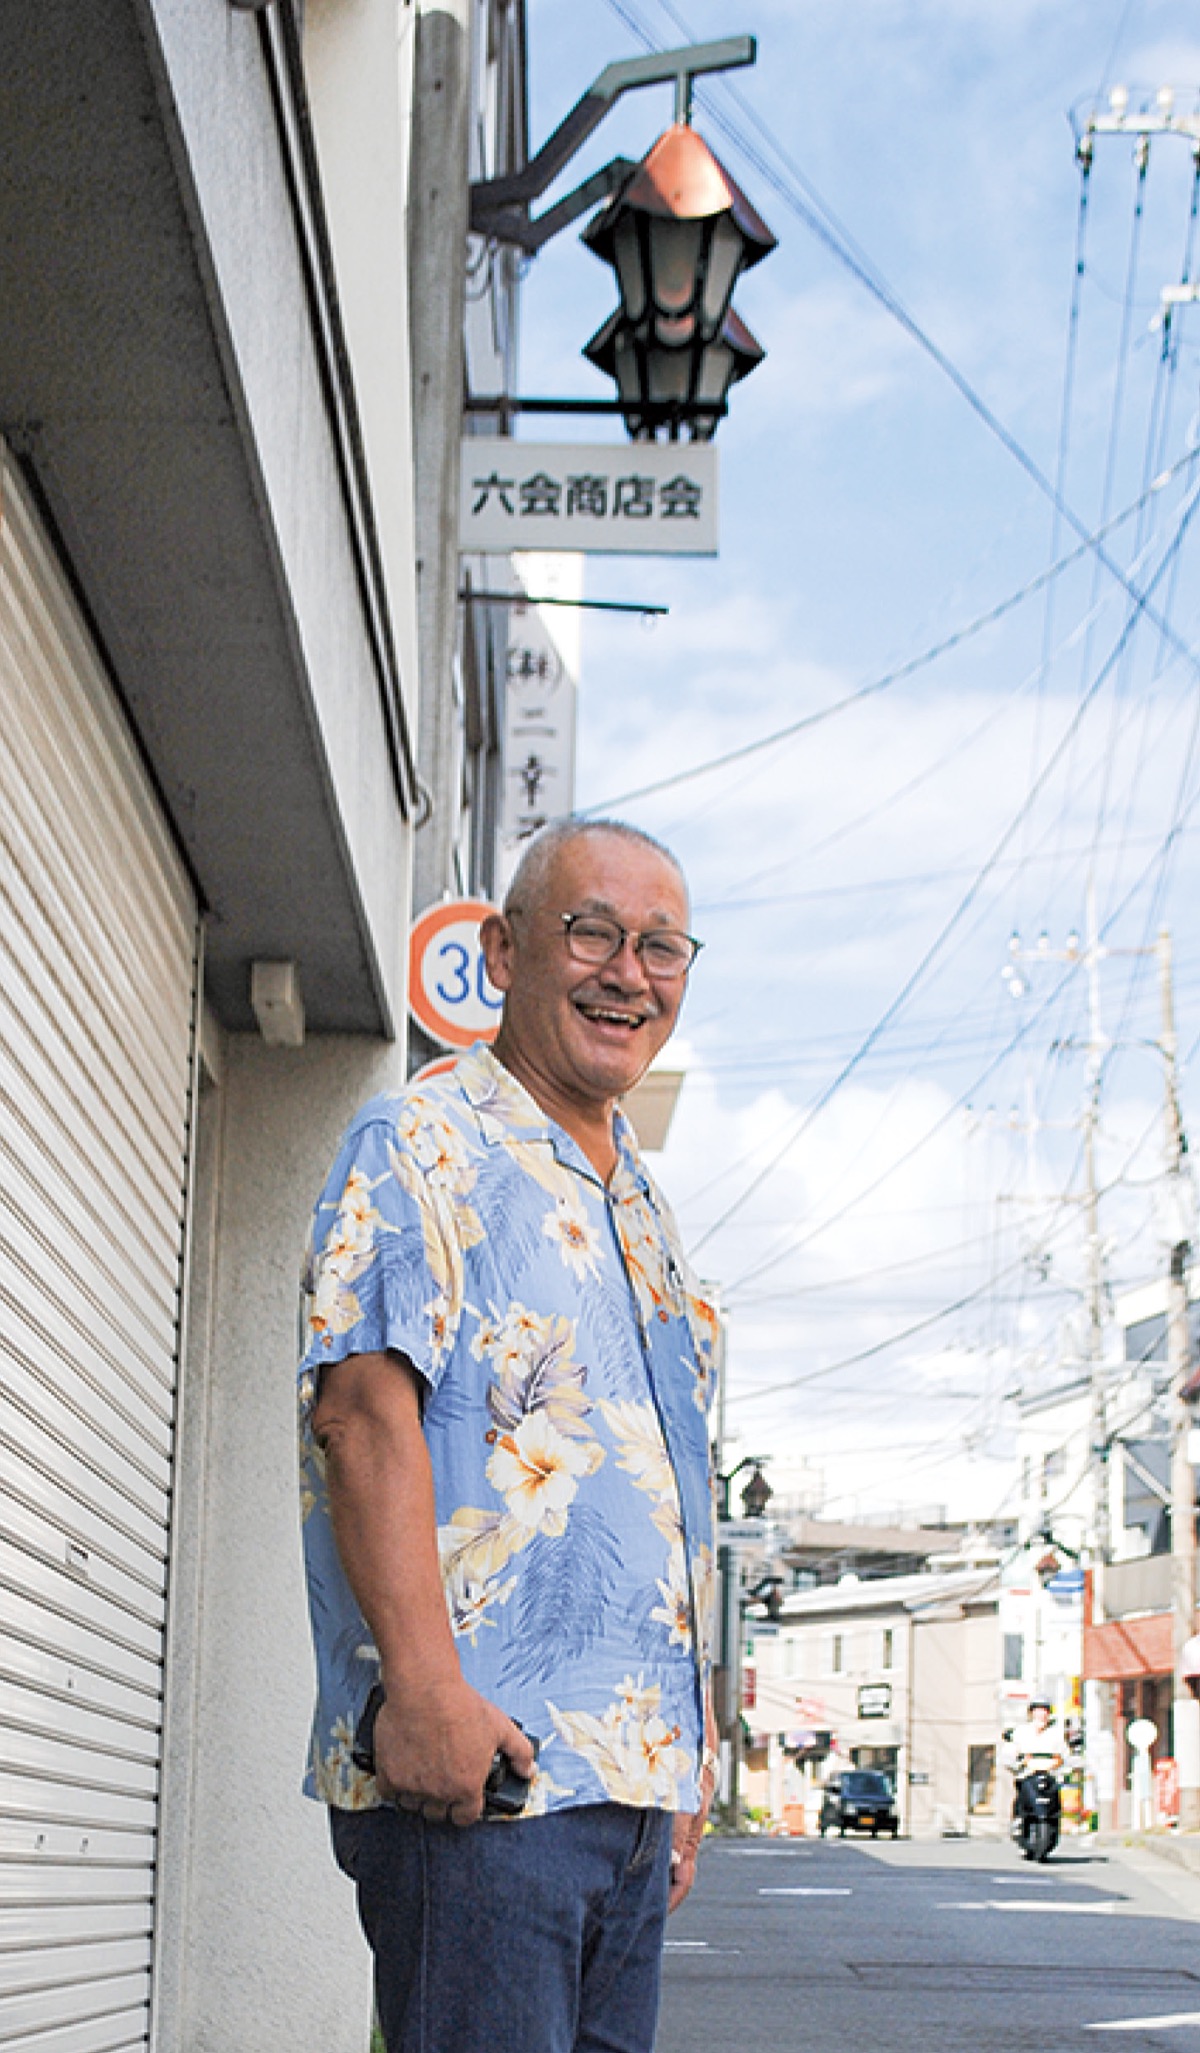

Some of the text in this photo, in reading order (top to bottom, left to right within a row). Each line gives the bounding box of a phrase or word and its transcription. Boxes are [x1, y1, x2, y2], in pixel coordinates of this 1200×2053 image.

[472, 471, 702, 518] 六会商店会
